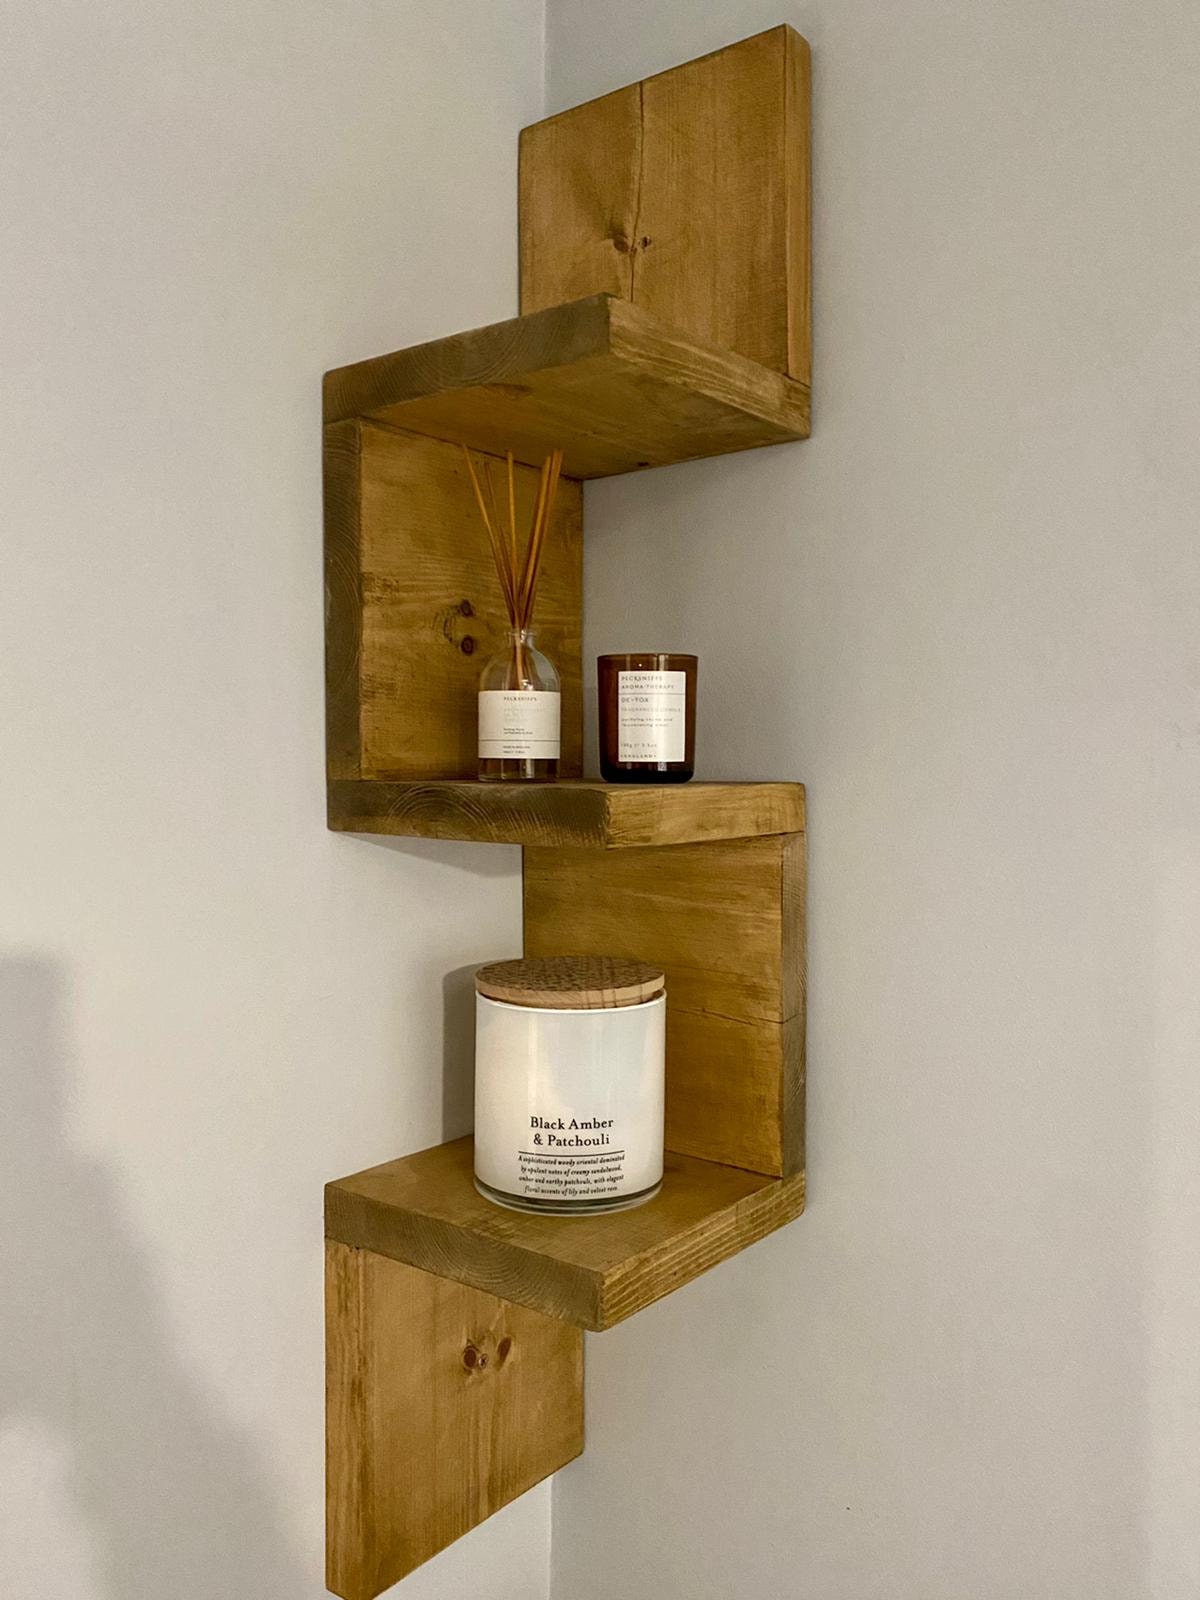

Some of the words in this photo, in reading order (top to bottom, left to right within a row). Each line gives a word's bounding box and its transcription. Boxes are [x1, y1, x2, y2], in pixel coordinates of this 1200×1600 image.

[530, 1116, 565, 1130] Black
[568, 1117, 614, 1130] Amber
[533, 1133, 543, 1146] &
[547, 1133, 610, 1147] Patchouli
